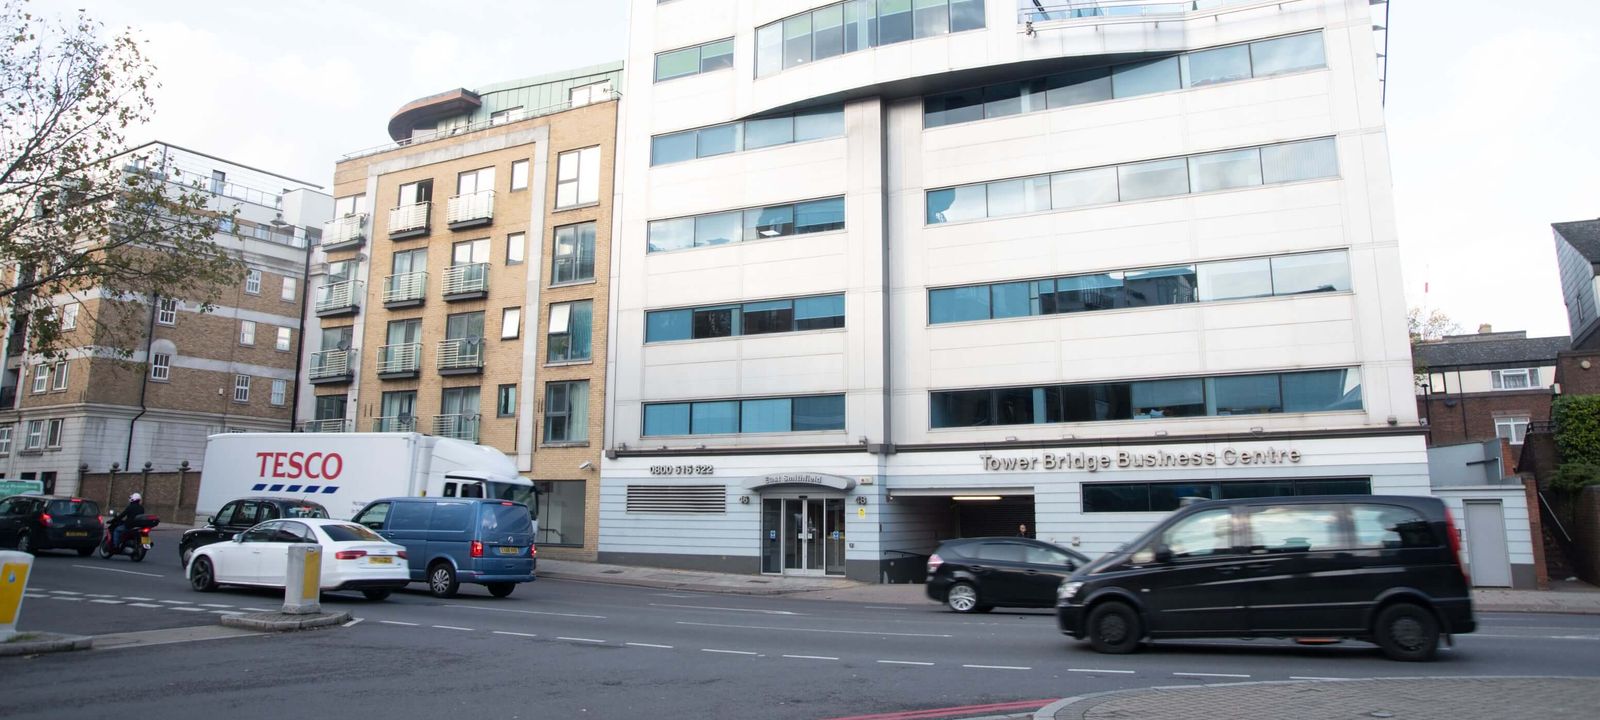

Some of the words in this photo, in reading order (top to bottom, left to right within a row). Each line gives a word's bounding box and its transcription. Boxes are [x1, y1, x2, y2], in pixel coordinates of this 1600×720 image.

[256, 451, 343, 480] TESCO
[980, 453, 1038, 471] Tower
[1042, 451, 1111, 472] Bridge
[1117, 448, 1217, 467] Business
[1222, 446, 1301, 465] Centre
[649, 465, 673, 475] 0800
[765, 476, 781, 484] East
[783, 474, 822, 484] Smithfield
